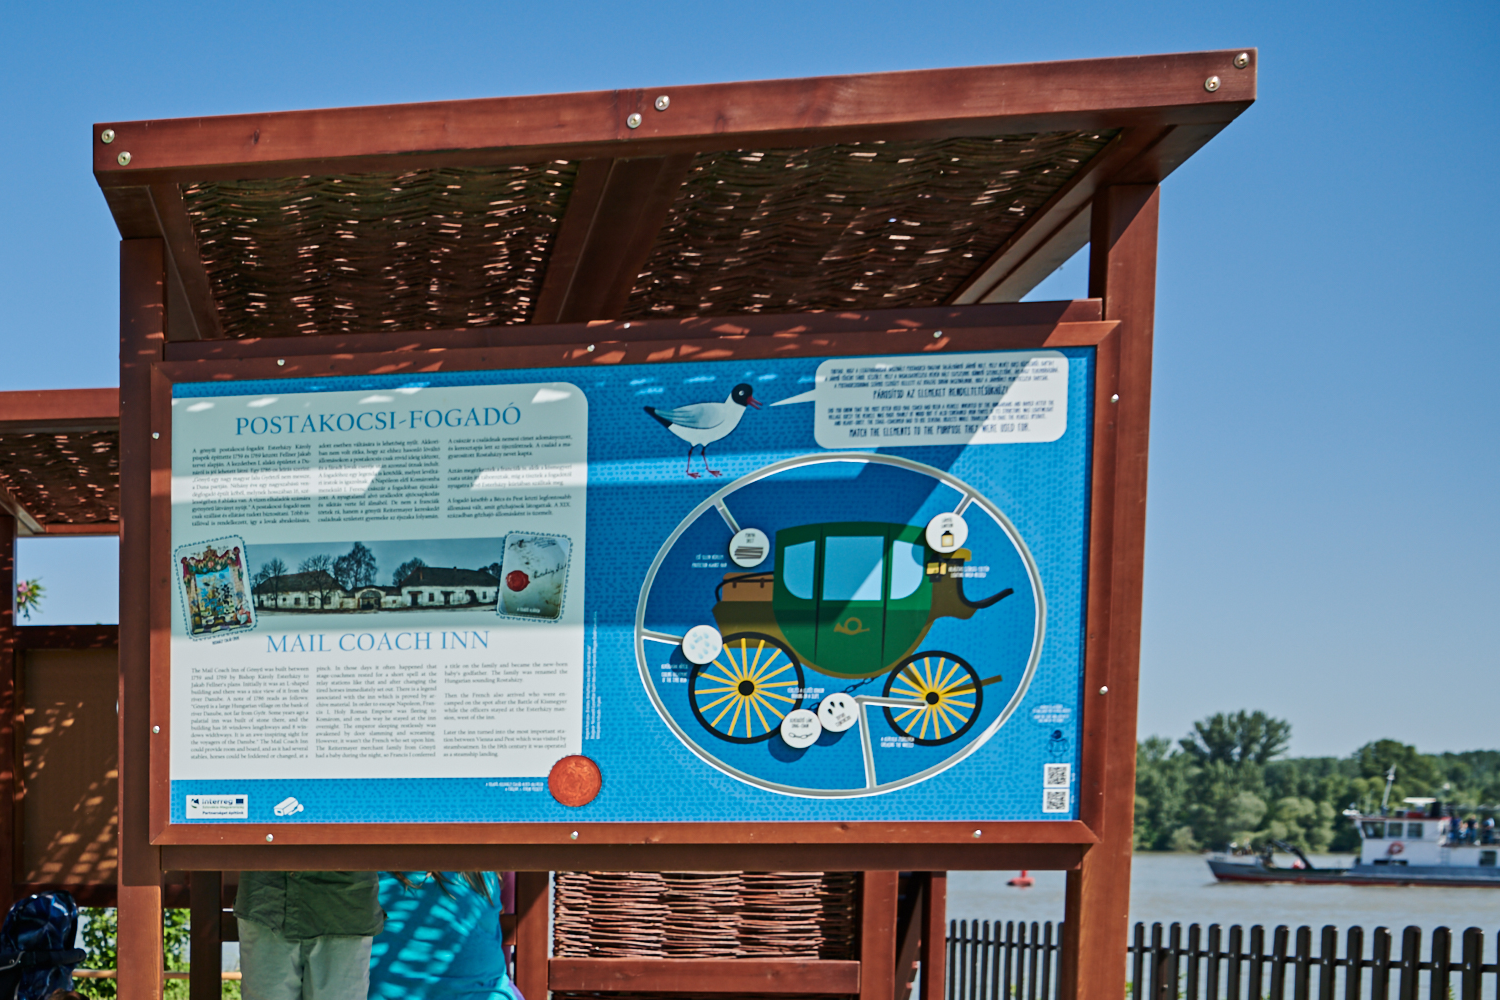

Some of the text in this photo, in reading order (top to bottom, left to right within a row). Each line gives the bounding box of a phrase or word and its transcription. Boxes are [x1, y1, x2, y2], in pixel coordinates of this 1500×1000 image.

[906, 389, 915, 398] AZ
[235, 402, 522, 435] POSTAKOCSI-FOGADÓ
[849, 428, 867, 438] MATCH
[870, 428, 880, 437] THE
[883, 427, 910, 437] ELEMENTS
[914, 428, 920, 436] TO
[924, 426, 934, 435] THE
[937, 425, 961, 434] PURPOSE
[982, 423, 997, 433] WERE
[1000, 423, 1015, 432] USED
[266, 630, 490, 654] MAIL COACH INN
